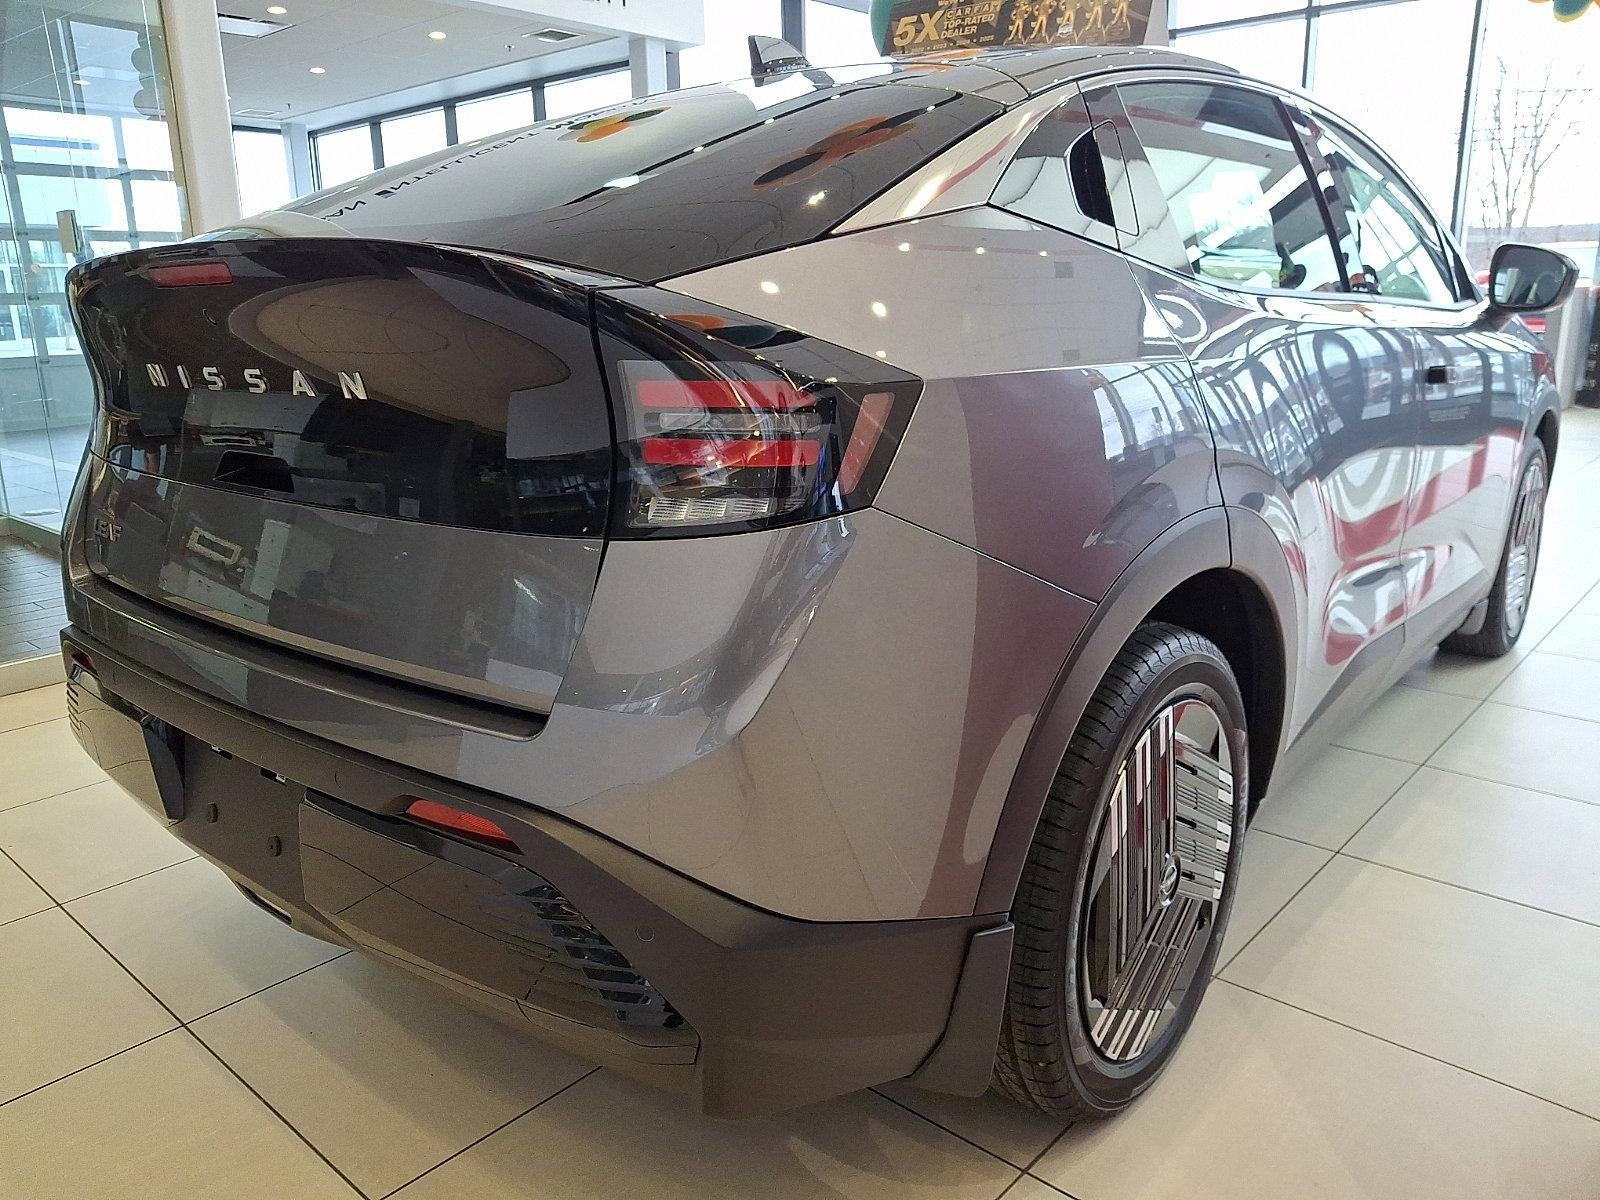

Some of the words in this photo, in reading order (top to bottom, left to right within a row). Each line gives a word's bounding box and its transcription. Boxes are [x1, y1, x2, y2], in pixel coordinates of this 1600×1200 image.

[893, 10, 944, 46] 5X
[940, 25, 977, 39] DEALER
[943, 13, 995, 29] TOP-RATED
[146, 363, 368, 400] NISSAN
